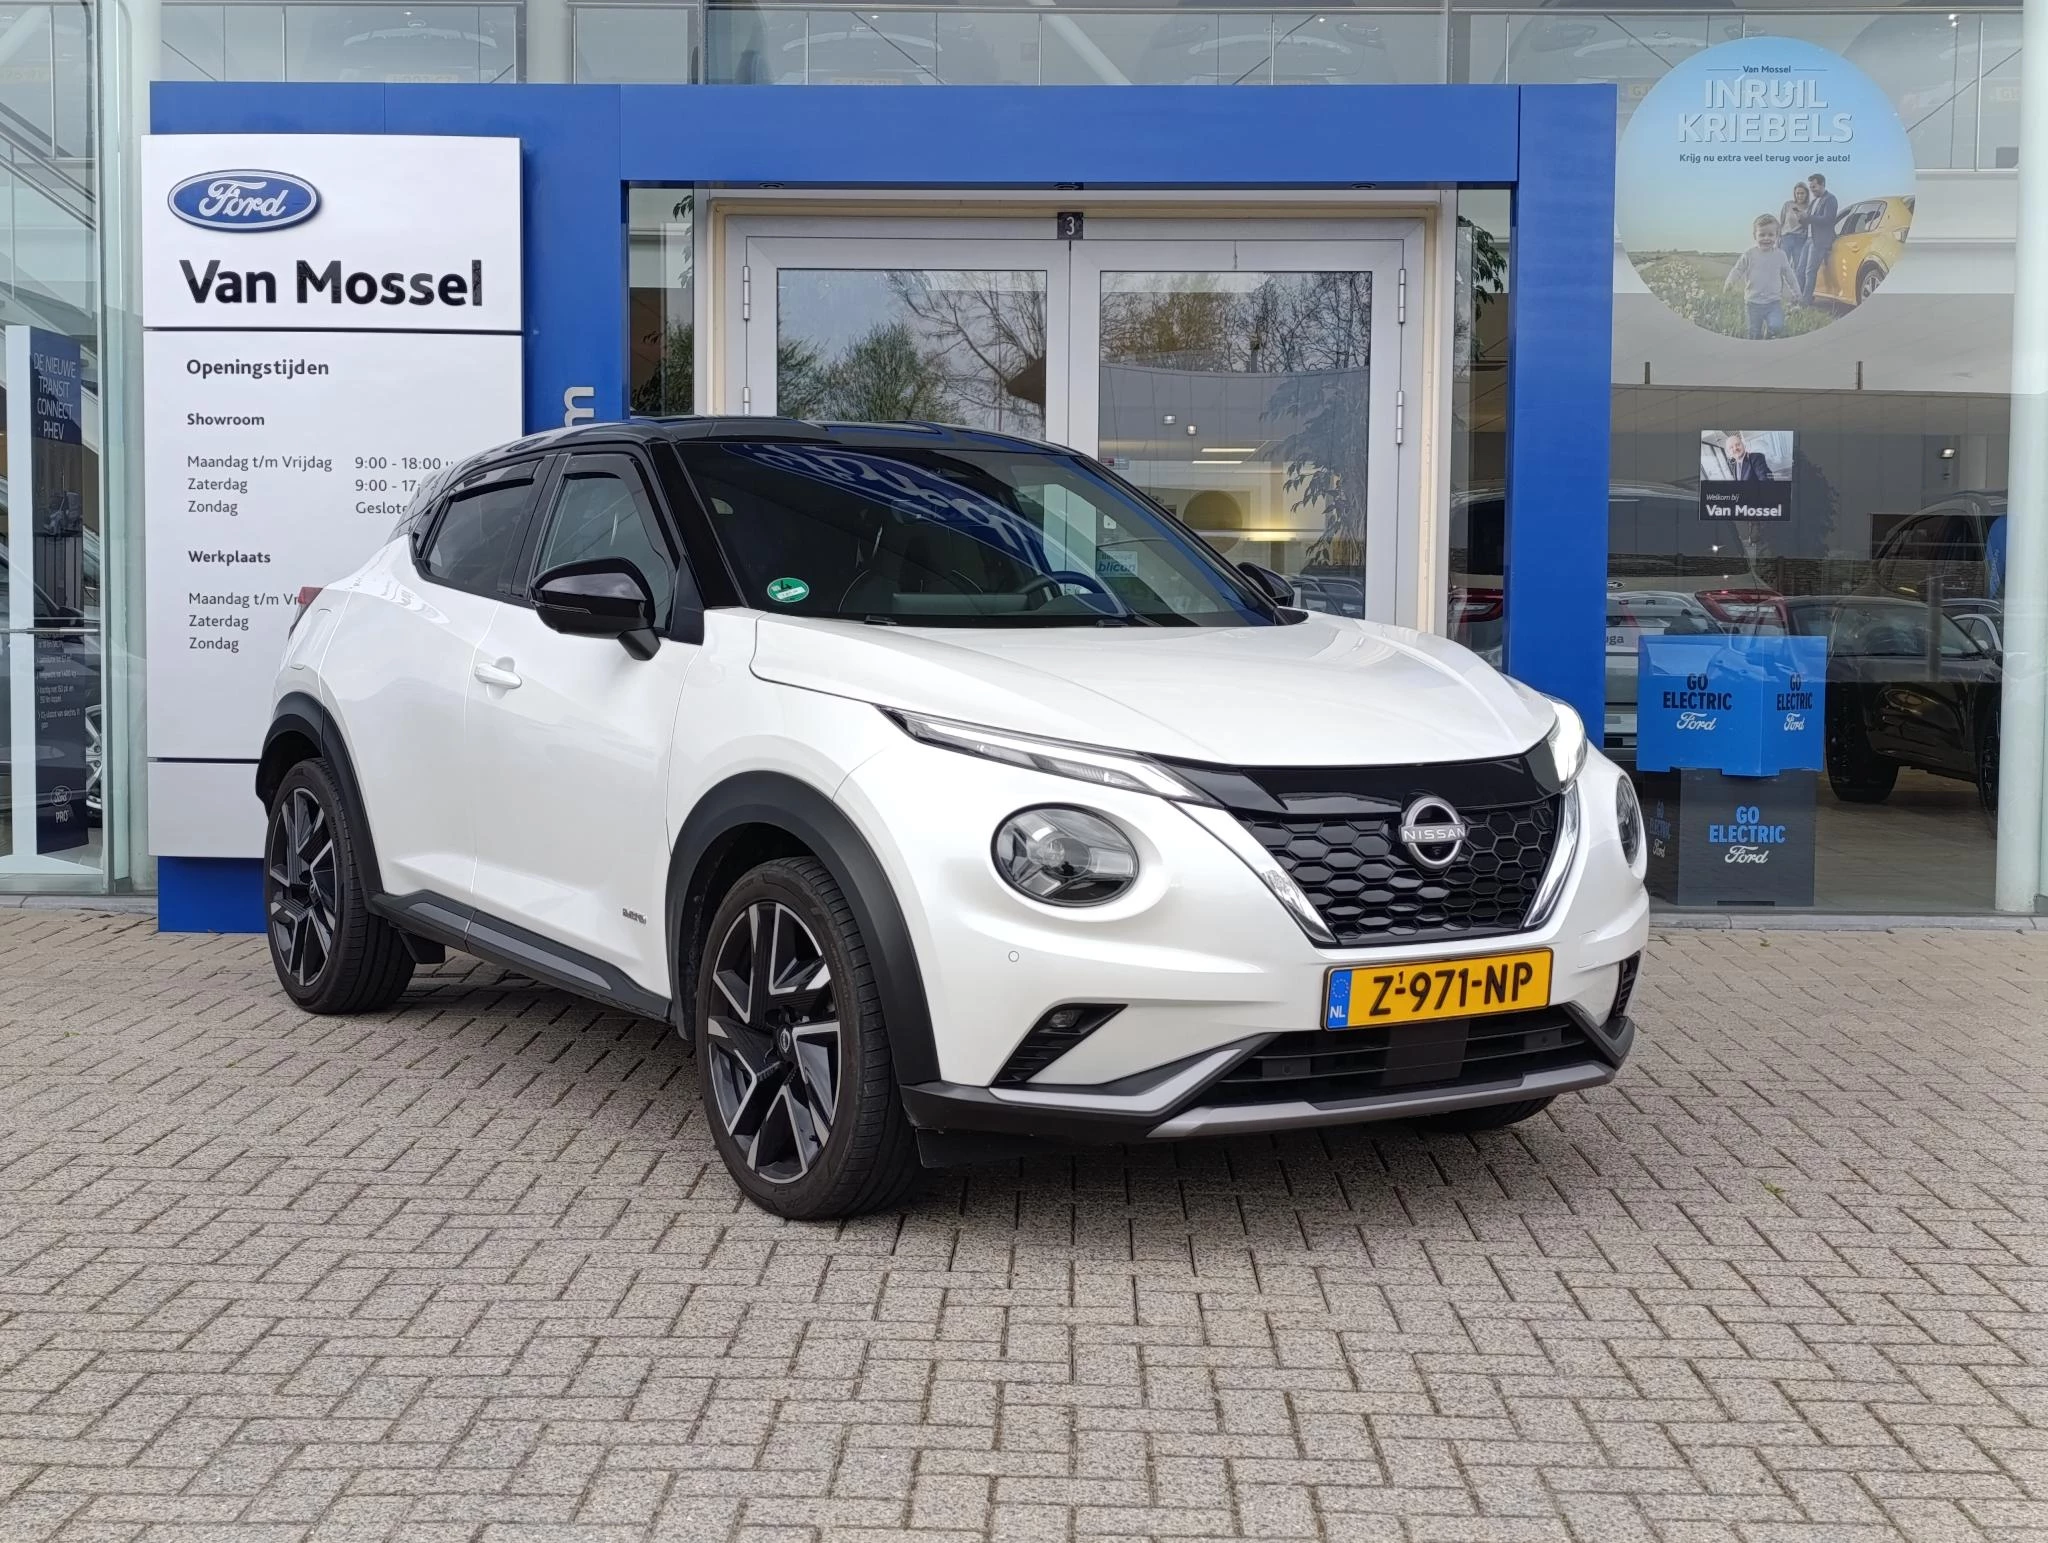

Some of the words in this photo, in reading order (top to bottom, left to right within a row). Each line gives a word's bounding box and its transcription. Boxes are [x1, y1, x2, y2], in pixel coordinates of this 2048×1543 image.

[1743, 65, 1759, 73] Van
[1761, 65, 1791, 73] Mossel
[1705, 78, 1829, 109] INRUIL
[1678, 112, 1854, 143] KRIEBELS
[1679, 153, 1701, 163] Krijg
[1717, 154, 1742, 162] extra
[1744, 153, 1763, 162] veel
[1765, 154, 1791, 163] terug
[1815, 153, 1825, 163] je
[1826, 153, 1851, 162] auto!
[199, 179, 289, 217] Ford
[1066, 216, 1075, 235] 3
[179, 260, 277, 304] Van
[296, 260, 483, 307] Mossel
[33, 352, 44, 372] DE
[45, 355, 76, 378] NIEUWE
[186, 358, 330, 380] Openingstijden
[38, 375, 70, 398] TRANSIT
[37, 398, 73, 420] CONNECT
[187, 412, 266, 426] Showroom
[43, 420, 64, 440] PHEV
[187, 455, 249, 472] Maandag
[252, 455, 279, 469] t/m
[282, 455, 333, 473] Vrijdag
[355, 456, 387, 470] 9:00
[401, 457, 441, 470] 18:00
[187, 477, 249, 495] Zaterdag
[355, 479, 387, 492] 9:00
[1706, 493, 1731, 501] Welkom
[1731, 493, 1740, 503] bij
[187, 500, 239, 517] Zondag
[1706, 504, 1731, 517] Van
[1735, 504, 1782, 517] Mossel
[188, 550, 271, 566] Werkplaats
[188, 592, 250, 608] Maandag
[253, 592, 279, 606] t/m
[188, 614, 249, 631] Zaterdag
[188, 636, 240, 653] Zondag
[1686, 672, 1709, 690] GO
[1789, 673, 1802, 692] GO
[1663, 691, 1733, 710] ELECTRIC
[1776, 692, 1813, 711] ELECTRIC
[1676, 711, 1718, 731] Ford
[1783, 712, 1806, 731] Ford
[55, 810, 69, 823] PRO
[1735, 806, 1760, 825] GO
[1403, 827, 1466, 840] NISSAN
[1708, 824, 1786, 843] ELECTRIC
[1724, 845, 1769, 864] Ford
[1329, 1005, 1346, 1019] NL
